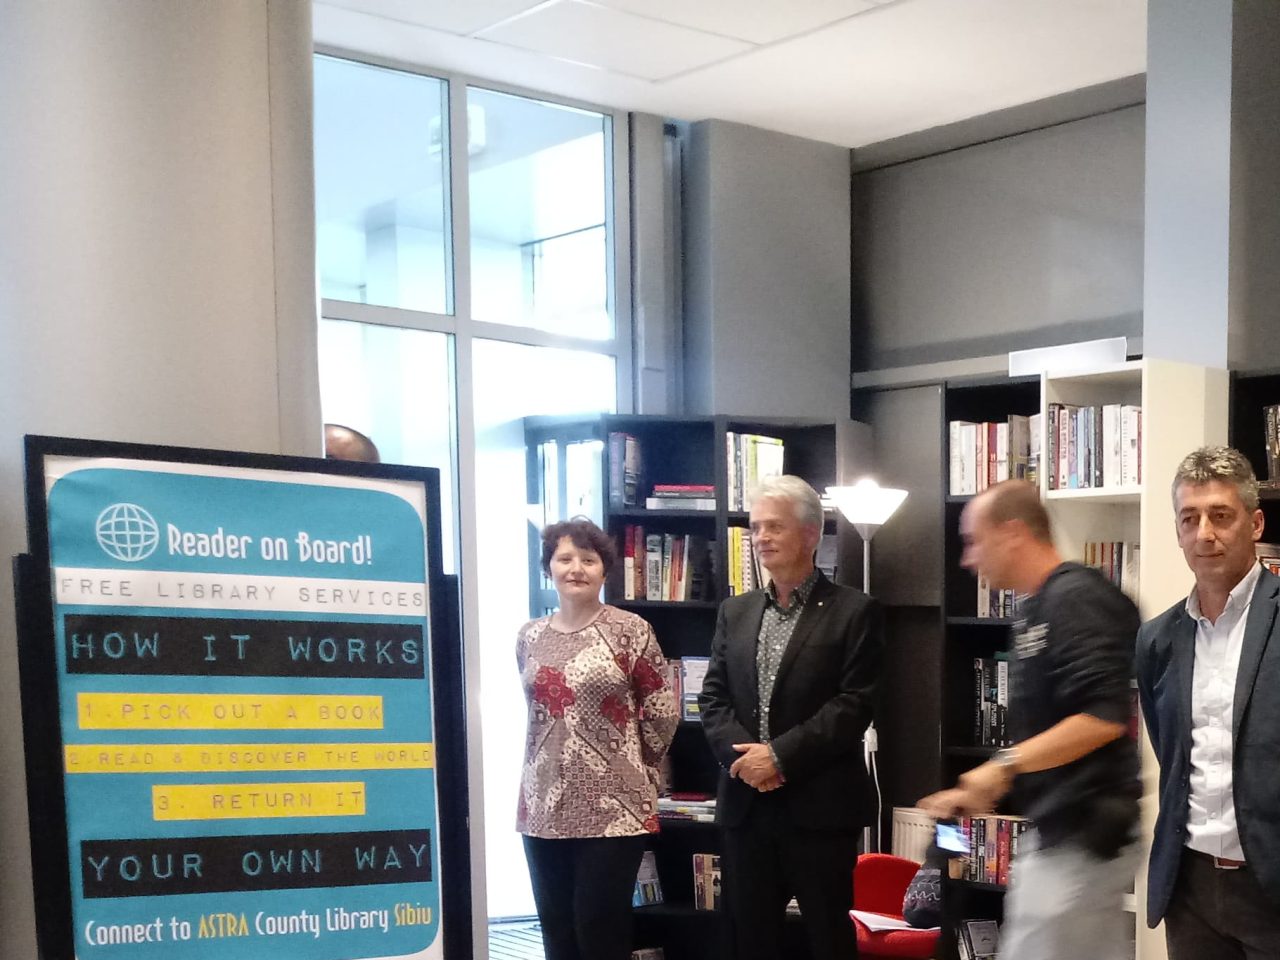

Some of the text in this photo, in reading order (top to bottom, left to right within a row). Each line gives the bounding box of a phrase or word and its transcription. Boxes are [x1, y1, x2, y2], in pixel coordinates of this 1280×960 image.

[166, 523, 373, 565] Reader on Board!
[60, 577, 424, 608] FREE LIBRARY SERVICES
[70, 631, 421, 665] HOW IT WORKS
[213, 703, 262, 721] OUT
[286, 704, 299, 721] A
[318, 703, 382, 721] BOOK
[200, 751, 308, 765] DISCOVER
[324, 750, 360, 764] THE
[373, 748, 431, 763] WORLD
[158, 790, 364, 811] 3. RETURN IT
[88, 843, 428, 883] YOUR OWN WAY
[84, 904, 432, 945] Connect to ASTRA County Library Sibiu
